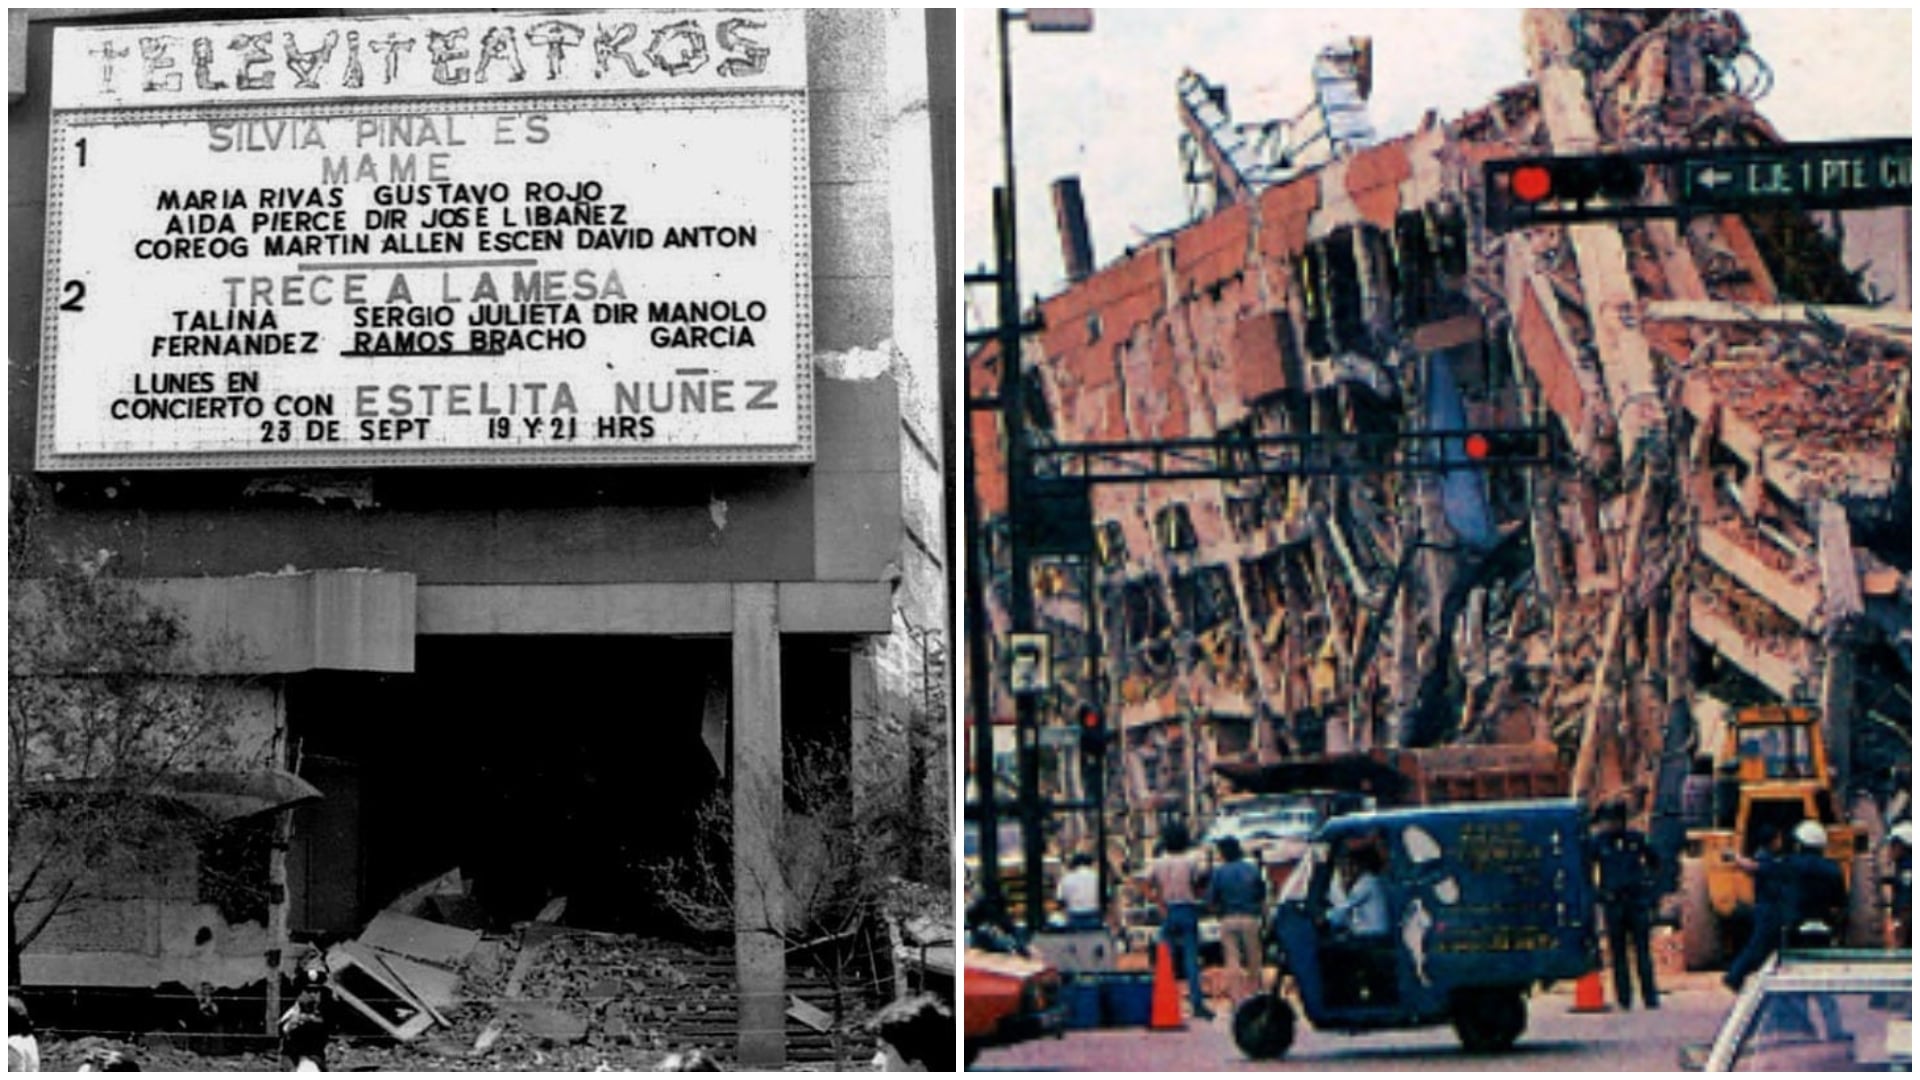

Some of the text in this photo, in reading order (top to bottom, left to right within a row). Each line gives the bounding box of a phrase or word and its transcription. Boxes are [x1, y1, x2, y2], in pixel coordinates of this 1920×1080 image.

[88, 18, 770, 94] TELEVITEATROS
[208, 115, 550, 151] SILVIA PINAL ES
[74, 138, 87, 167] 1
[322, 153, 449, 184] MAME
[1801, 161, 1813, 191] 1
[1822, 159, 1866, 191] PTE
[157, 181, 602, 210] MARIA RIVAS GUSTAVO ROJO
[166, 212, 234, 234] AIDA
[252, 212, 346, 232] PIERCE
[366, 210, 406, 229] DIR
[421, 207, 488, 229] JOSE
[135, 228, 756, 260] COREOG MARTIN ALLEN ESCEN DAVID ANTON
[60, 280, 86, 312] 2
[223, 274, 367, 307] TRECE
[386, 273, 412, 304] A
[512, 269, 626, 301] MESA
[173, 301, 766, 331] TALINA SERGIO JULIETA DIR MANOLO
[152, 332, 318, 357] FERNANDEZ
[353, 331, 453, 353] RAMOS
[470, 328, 586, 351] BRACHO
[135, 372, 258, 394] LUNES EN
[111, 397, 262, 419] CONCIERTO
[275, 394, 333, 417] CON
[356, 382, 578, 418] ESTELITA
[261, 421, 291, 442] 23
[307, 421, 339, 441] DE
[361, 419, 430, 440] SEPT
[488, 418, 510, 439] 19
[551, 417, 576, 439] 21
[598, 417, 654, 438] HRS
